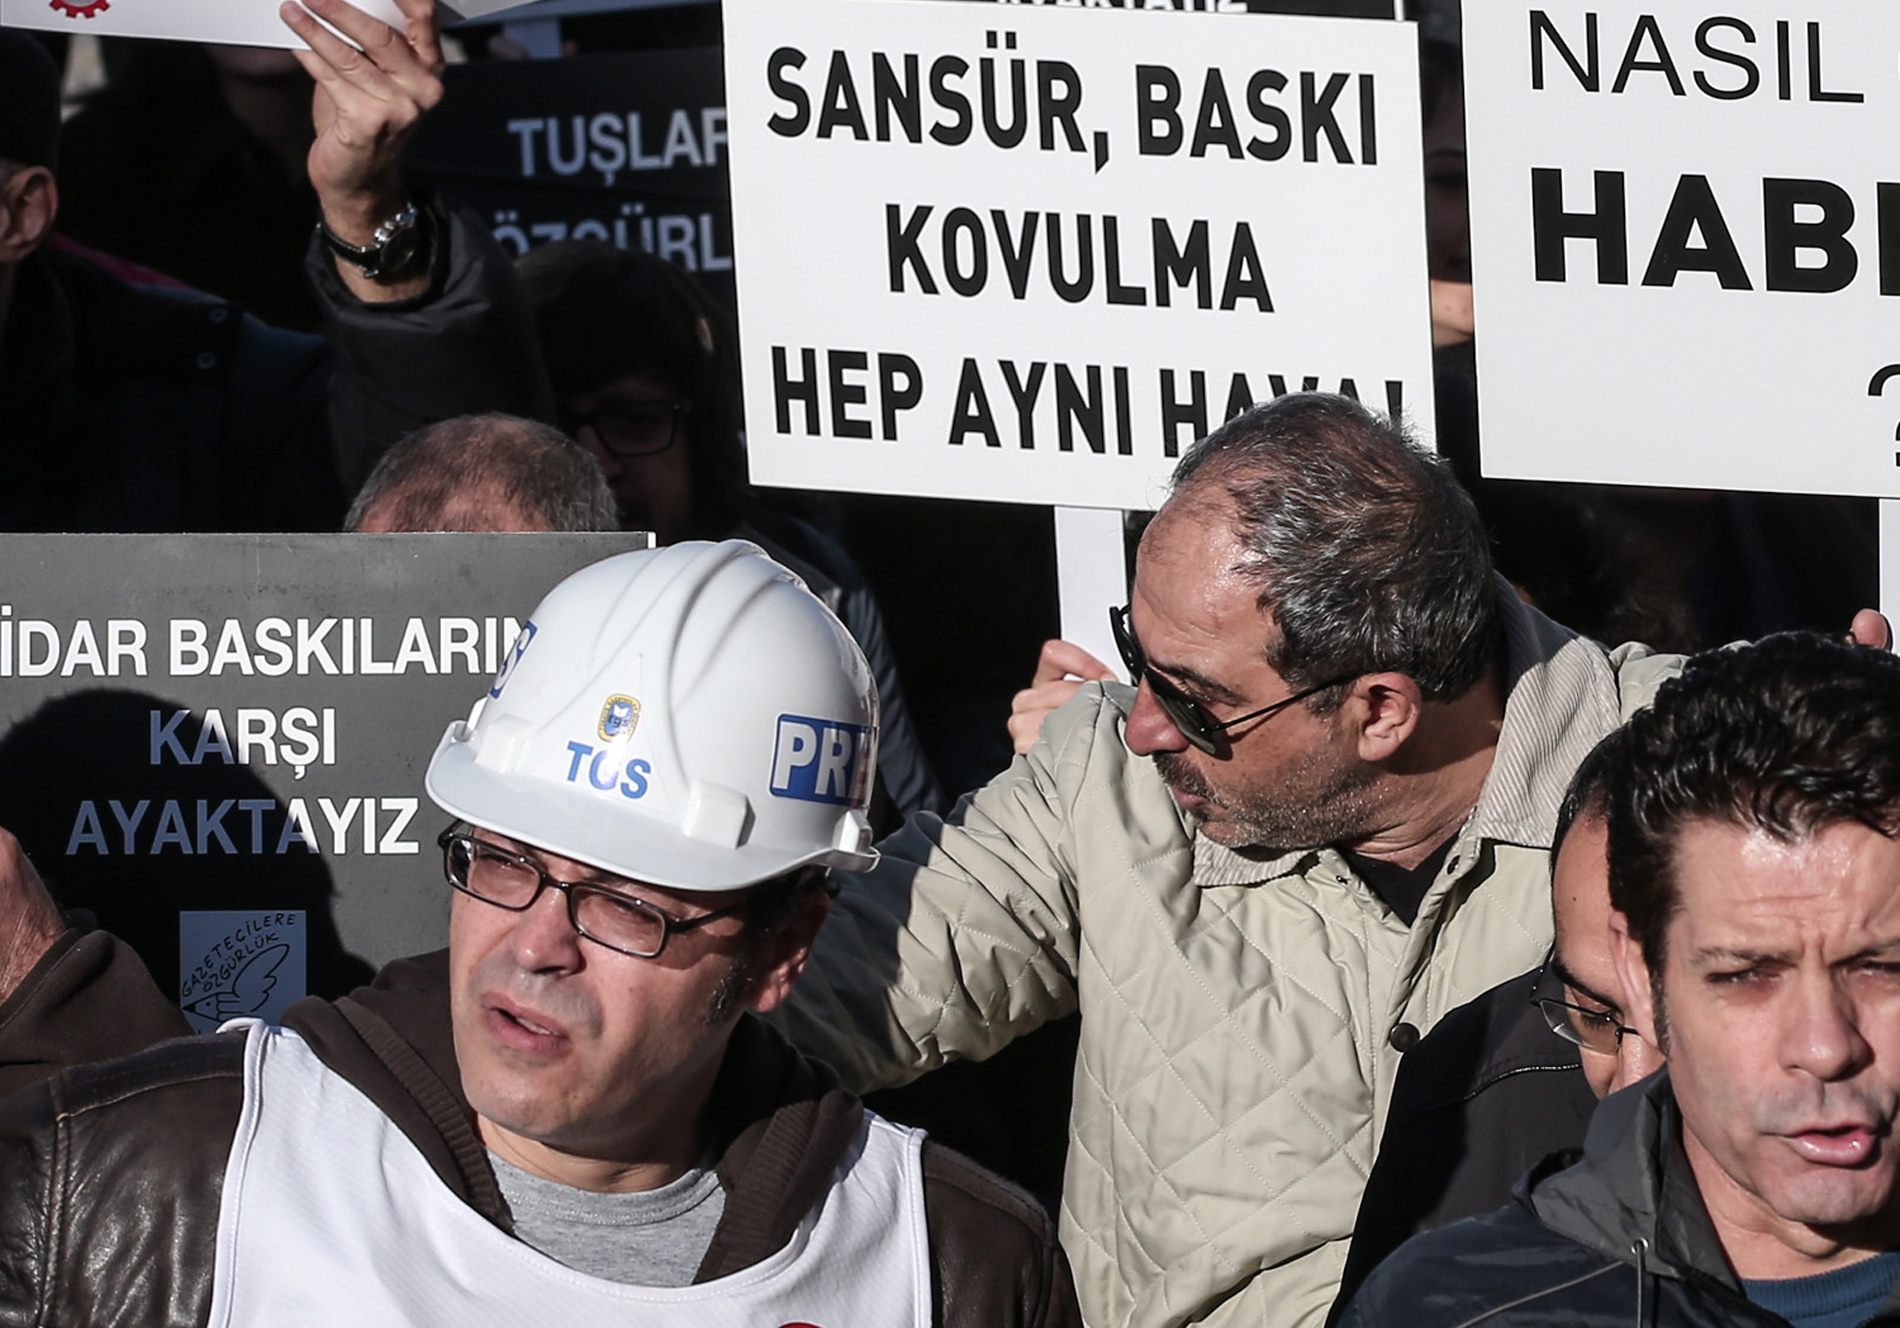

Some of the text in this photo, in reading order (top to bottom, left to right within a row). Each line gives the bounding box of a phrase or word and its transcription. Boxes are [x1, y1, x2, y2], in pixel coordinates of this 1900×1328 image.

[1528, 8, 1865, 104] NASIL
[766, 30, 1378, 176] SANSÜR, BASKI
[885, 202, 1276, 314] KOVULMA
[770, 344, 924, 441] HEP
[947, 356, 1134, 456] AYNI
[0, 604, 148, 678] İDAR
[148, 707, 337, 781] KARŞI
[64, 796, 421, 856] AYAKTAYIZ
[181, 913, 297, 998] GAZETECİLERE
